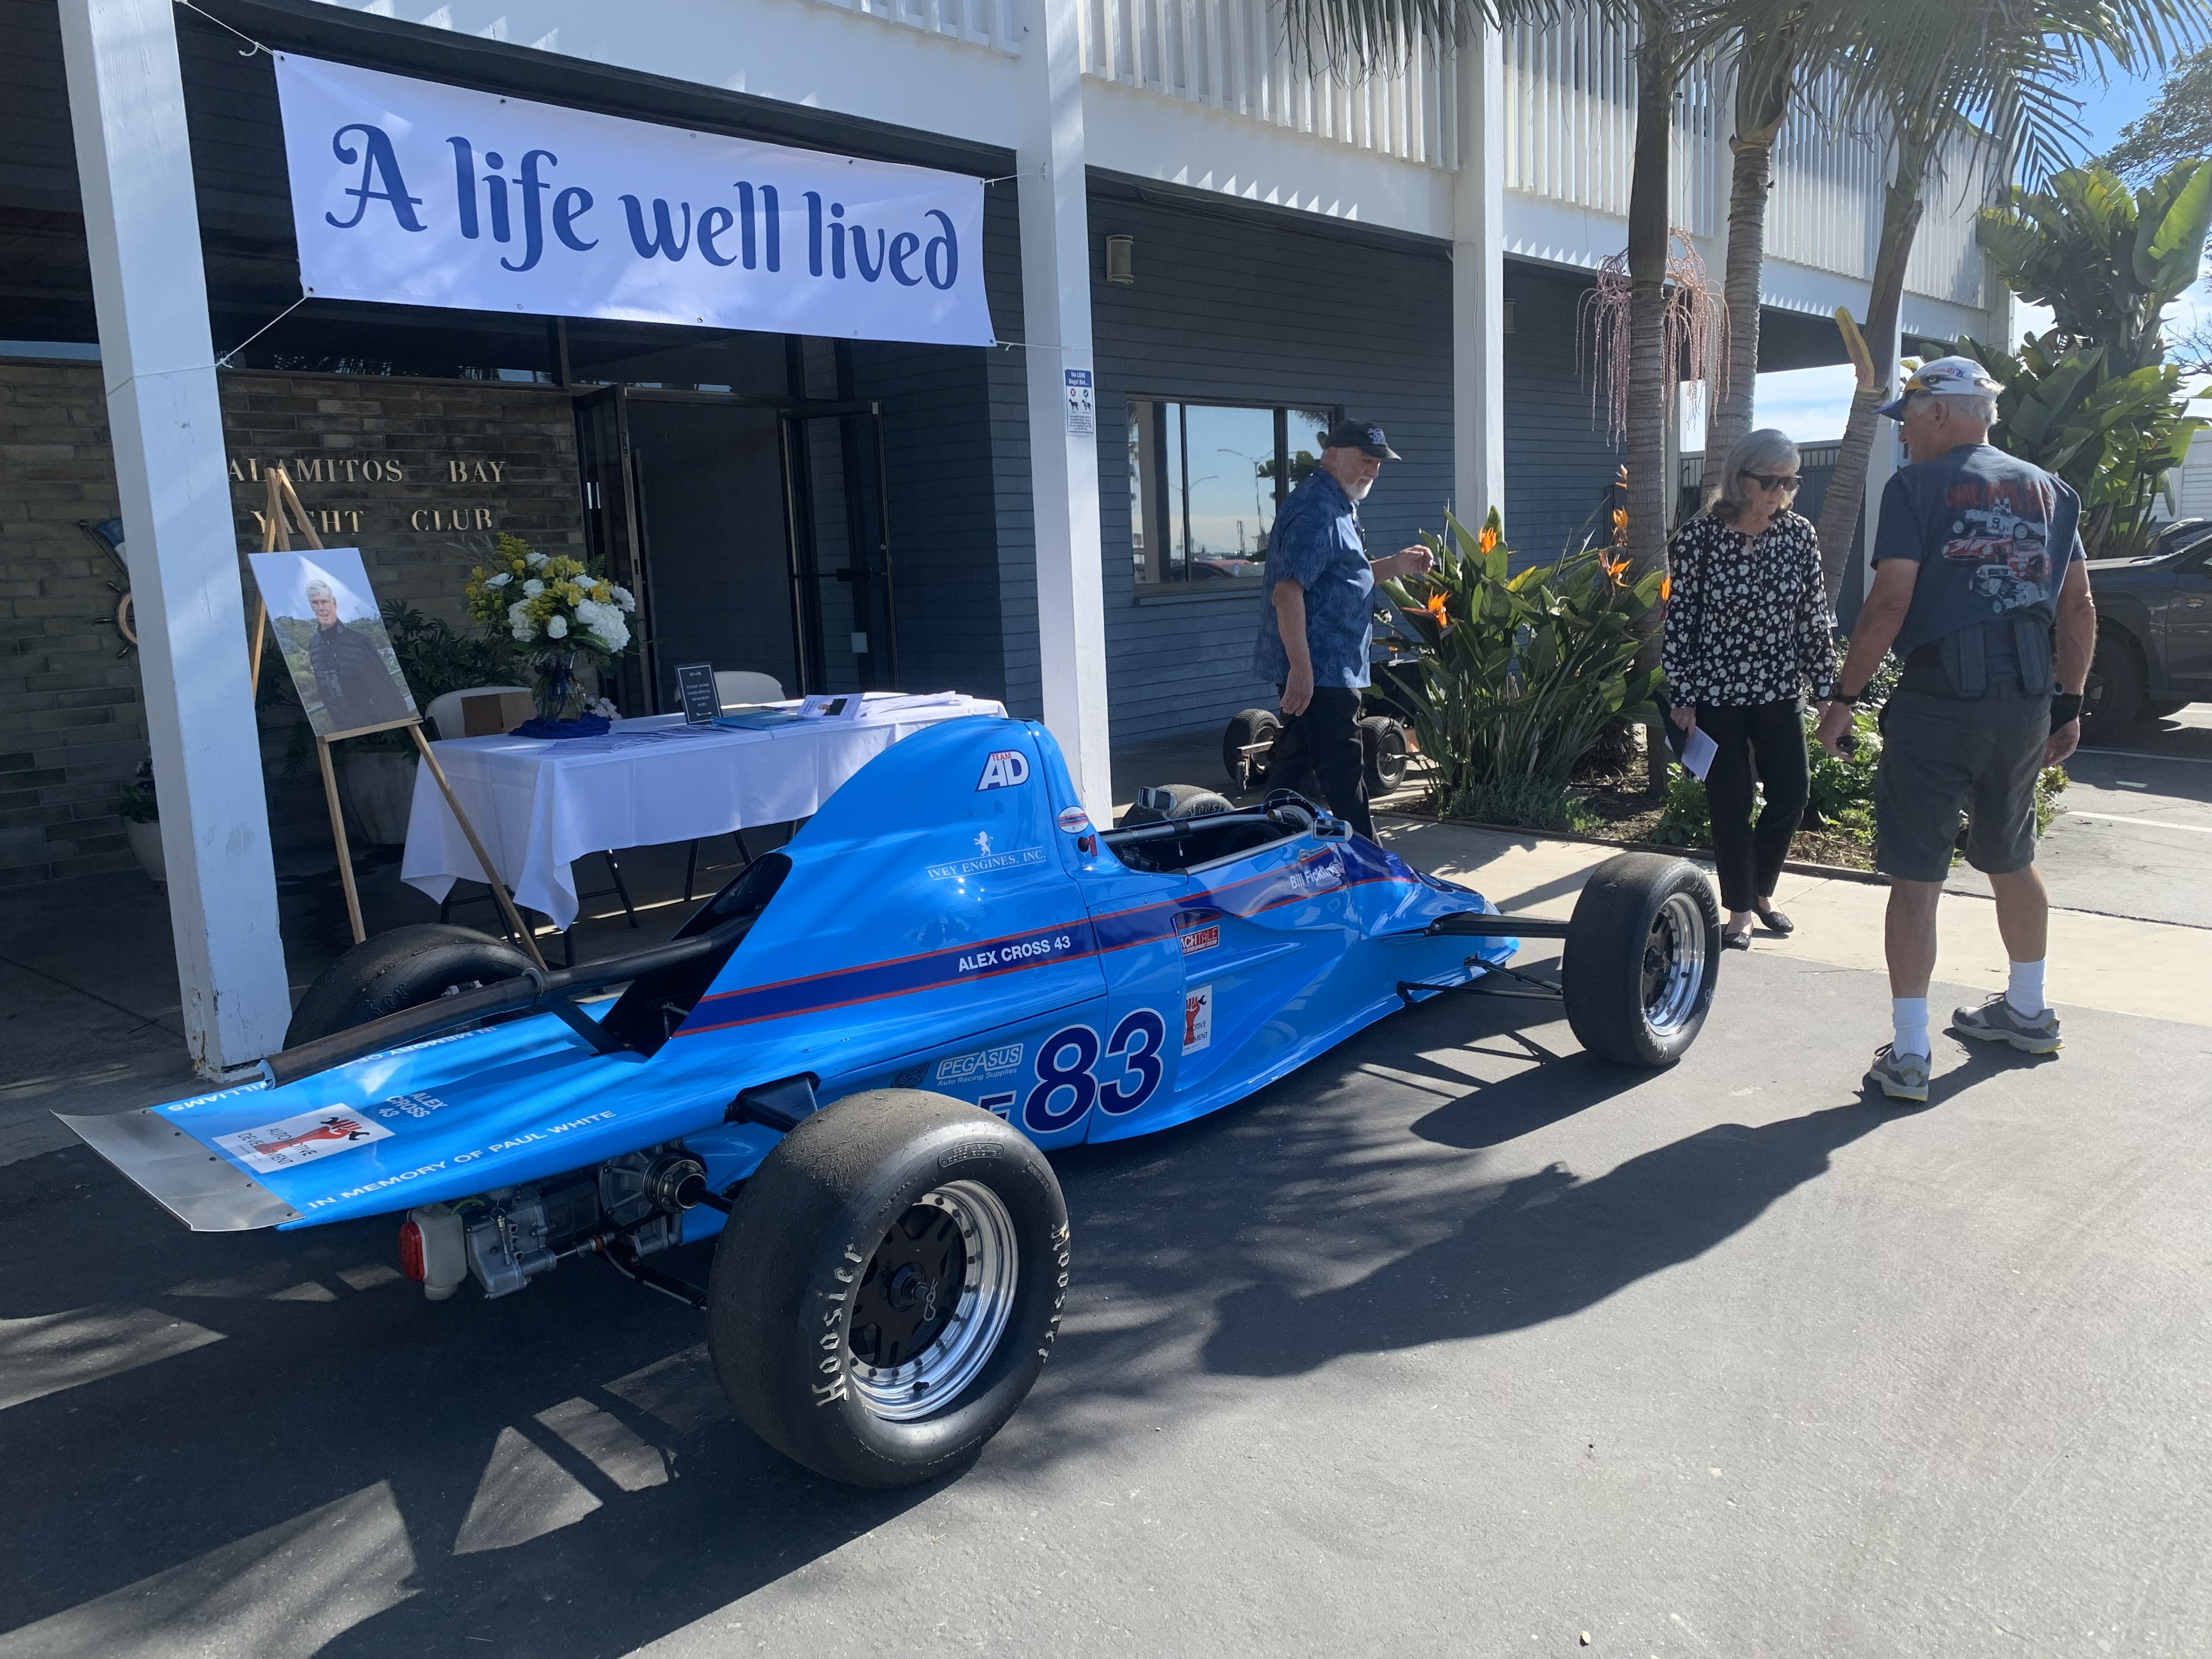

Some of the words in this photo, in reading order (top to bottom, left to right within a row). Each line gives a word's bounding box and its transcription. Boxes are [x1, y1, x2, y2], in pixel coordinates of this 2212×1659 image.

[325, 124, 427, 233] A
[445, 137, 599, 273] life
[618, 182, 780, 273] well
[802, 191, 959, 291] lived
[448, 460, 506, 483] BAY
[411, 508, 493, 532] CLUB
[992, 752, 1012, 761] TEAM
[977, 751, 1030, 791] AD
[927, 865, 958, 878] IVEY
[962, 855, 1019, 873] ENGINES,
[1023, 850, 1046, 862] INC.
[1289, 872, 1305, 889] Bill
[1304, 865, 1341, 884] Fickling
[958, 950, 998, 972] ALEX
[1001, 939, 1051, 962] CROSS
[1054, 935, 1071, 950] 43
[941, 1047, 1020, 1076] PEGASUS
[1024, 1007, 1166, 1134] 83
[937, 1079, 956, 1087] Auto
[957, 1073, 984, 1084] Racing
[985, 1068, 1017, 1079] Supplies
[379, 1108, 400, 1118] 43
[386, 1096, 431, 1118] CROSS
[409, 1092, 448, 1110] ALEX
[308, 1197, 338, 1209] IN
[340, 1160, 447, 1199] MEMORY
[453, 1149, 484, 1164] OF
[489, 1131, 548, 1153] PAUL
[546, 1110, 618, 1134] WHITE
